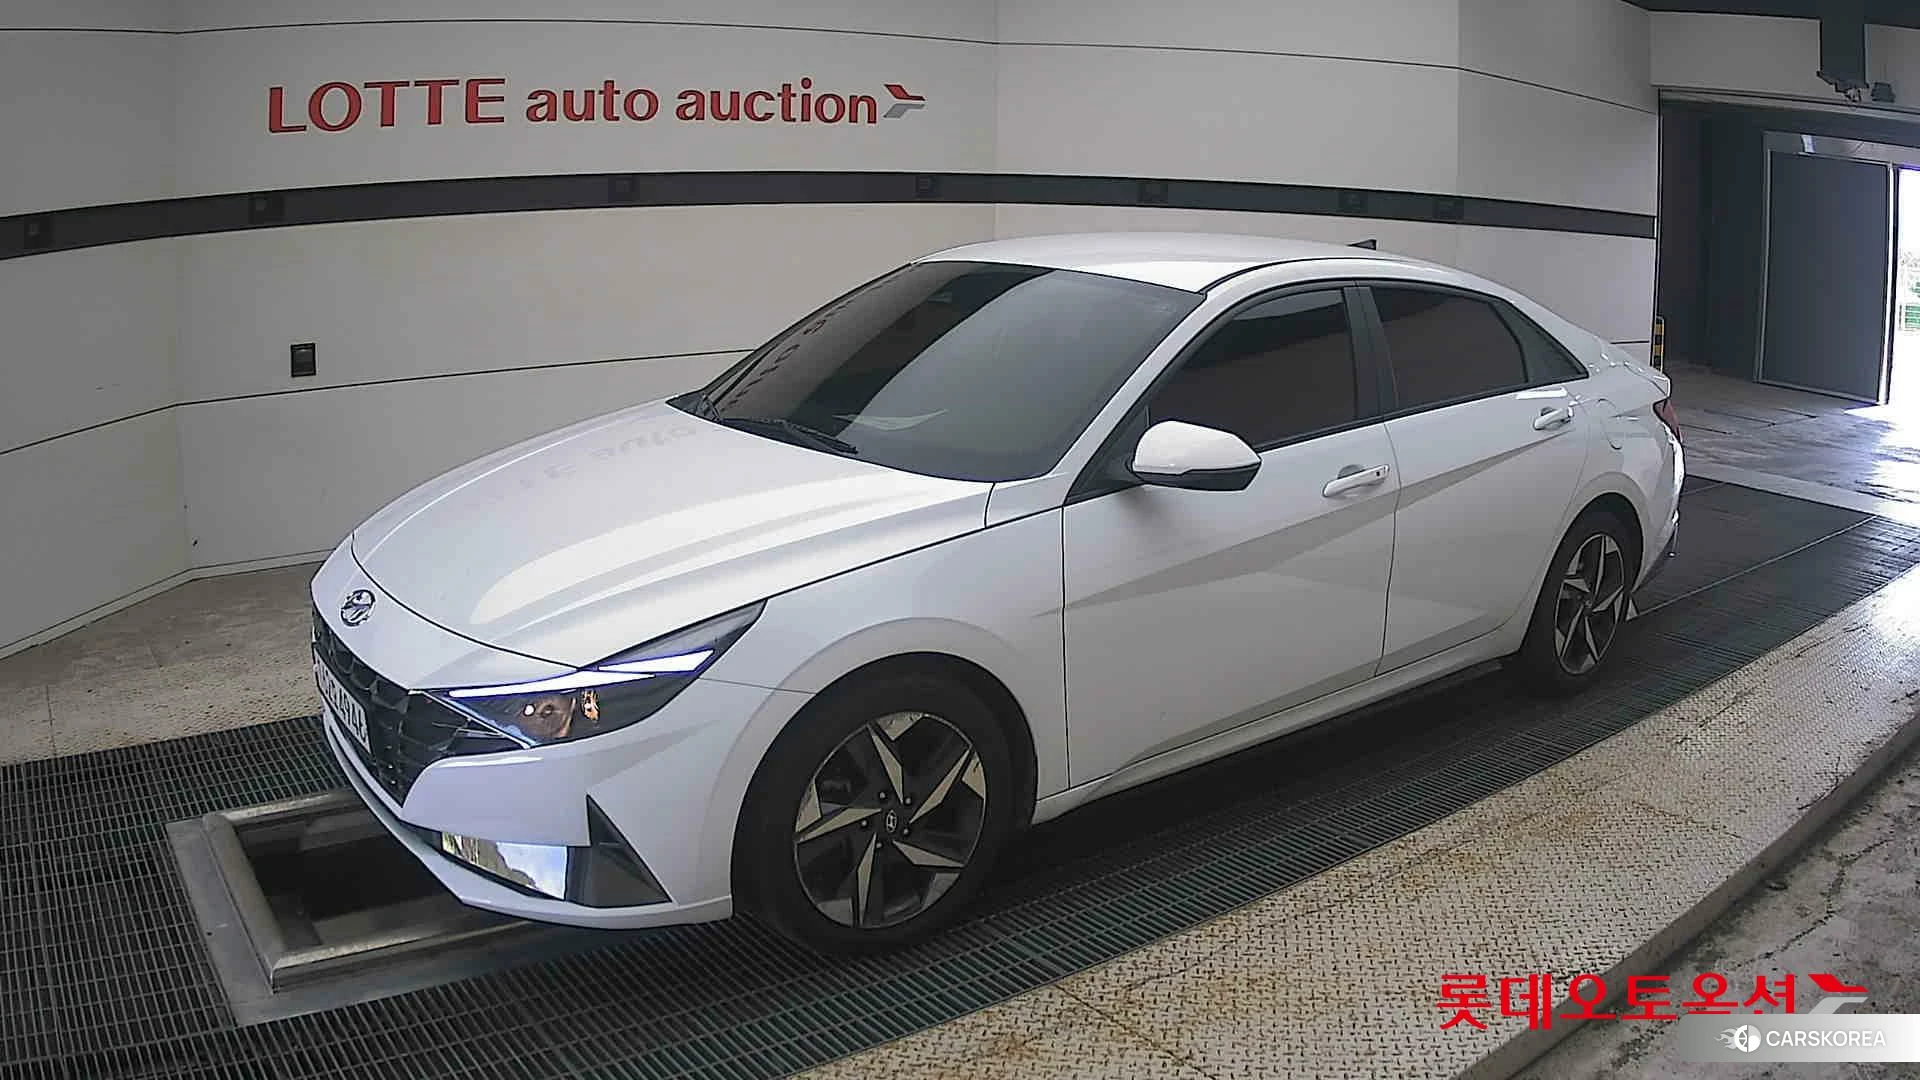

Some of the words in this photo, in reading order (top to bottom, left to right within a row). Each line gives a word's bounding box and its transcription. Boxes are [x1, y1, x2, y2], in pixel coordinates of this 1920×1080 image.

[268, 78, 505, 133] LOTTE
[527, 79, 659, 122] auto
[675, 78, 878, 125] auction
